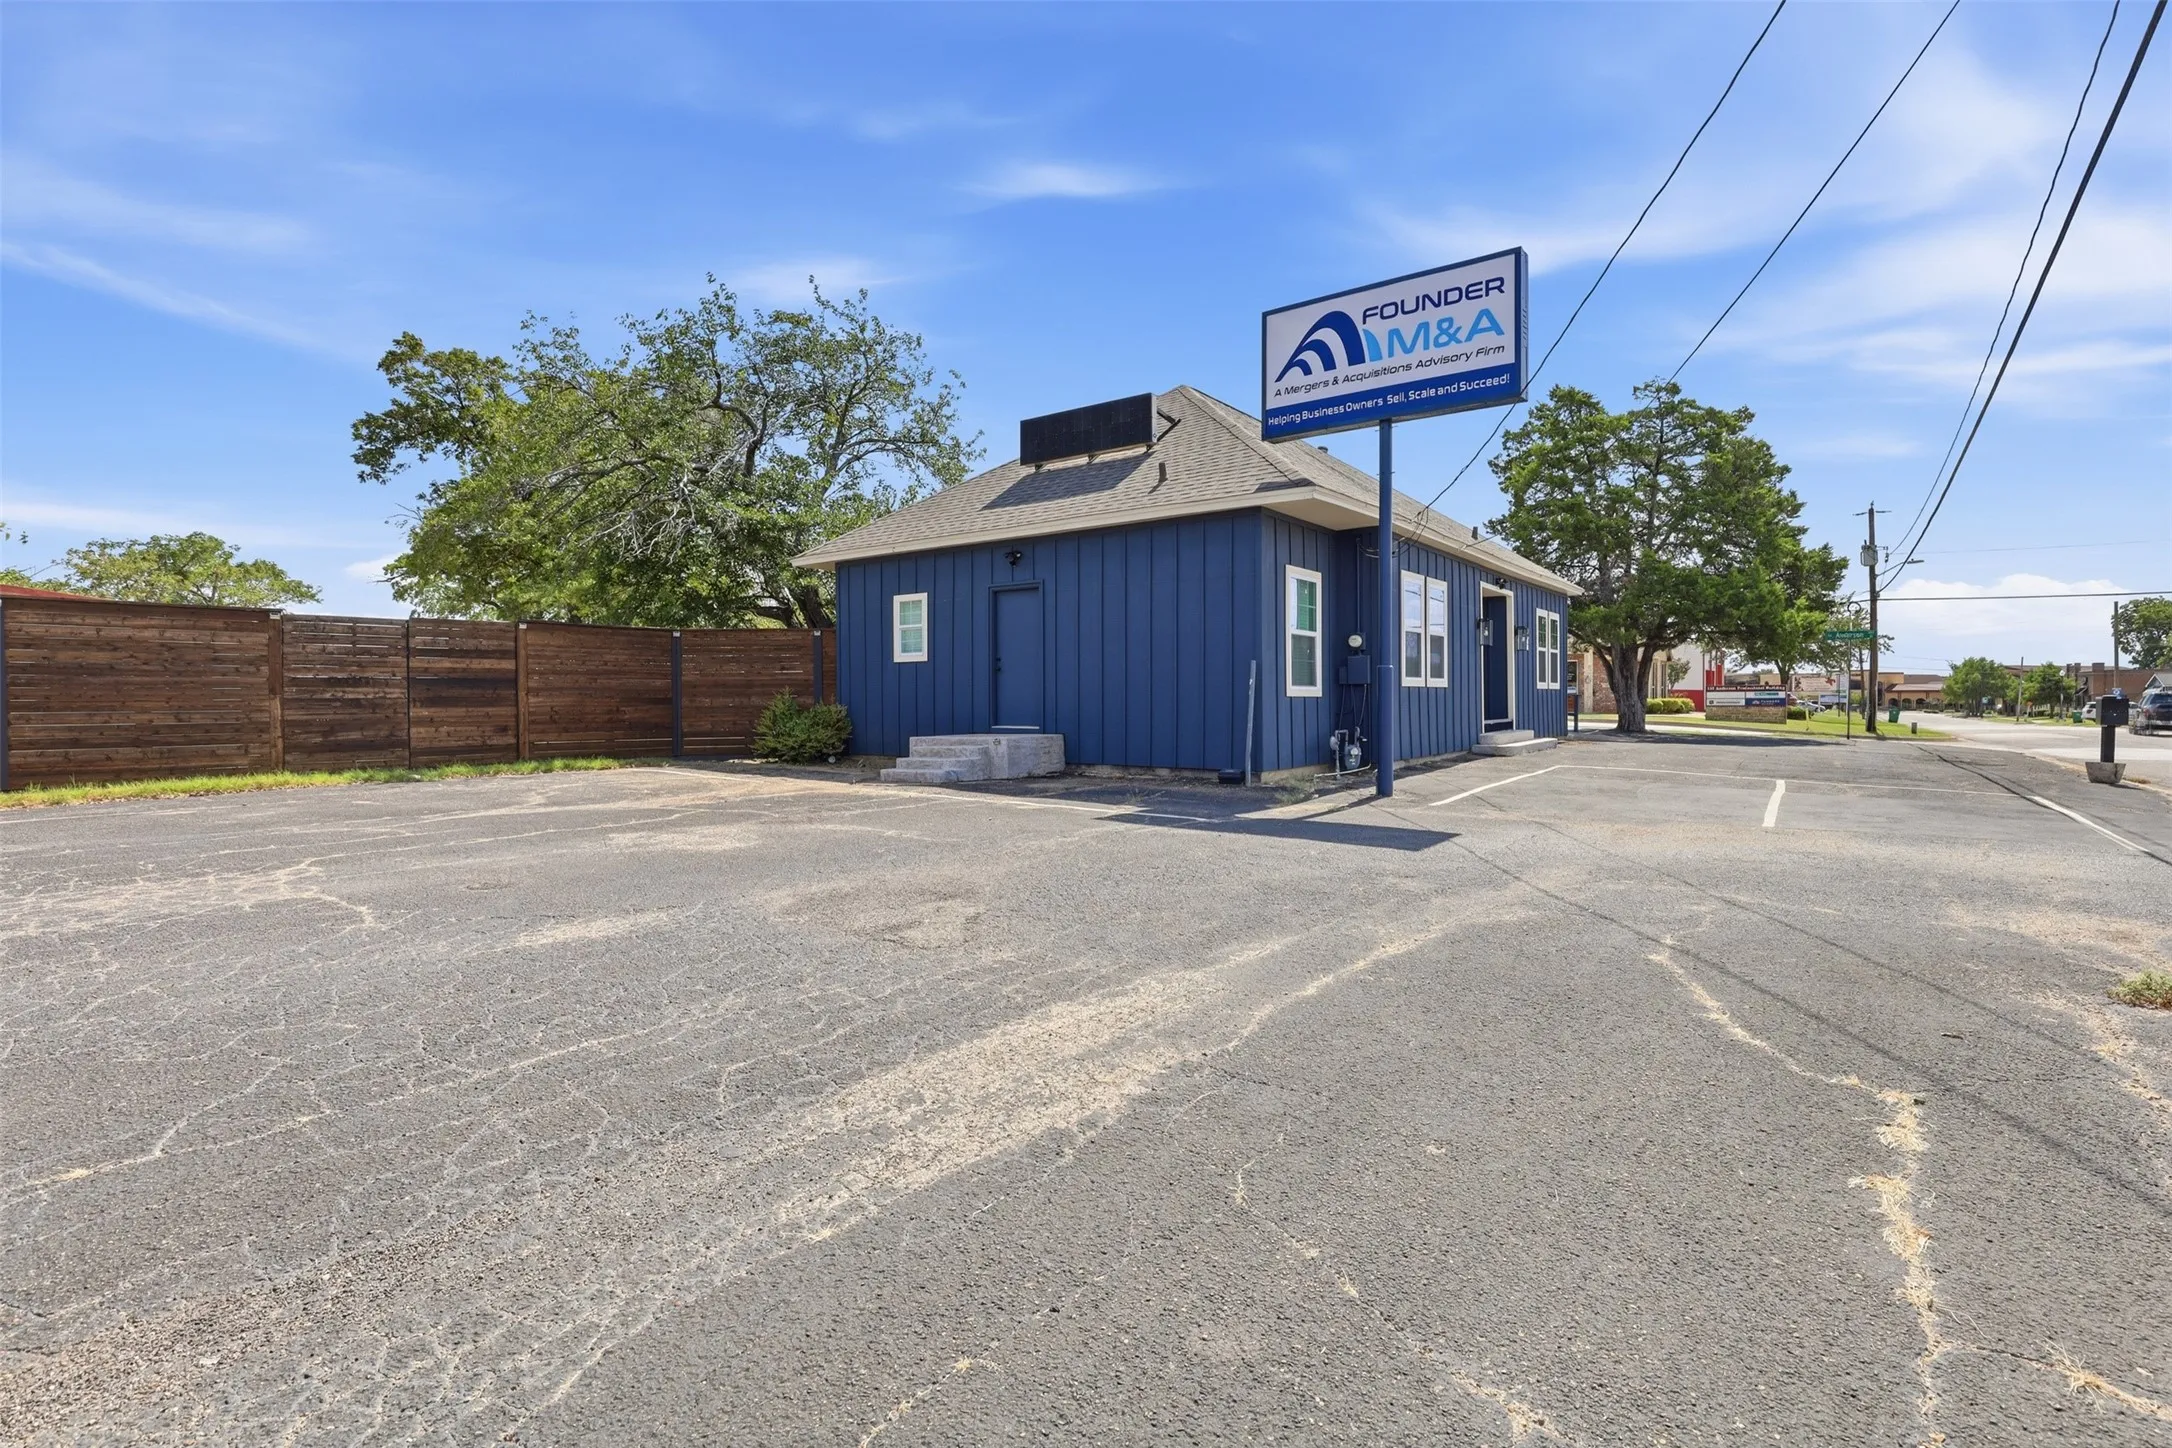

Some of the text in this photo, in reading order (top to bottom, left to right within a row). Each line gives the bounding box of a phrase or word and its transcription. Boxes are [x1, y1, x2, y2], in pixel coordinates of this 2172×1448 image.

[1362, 276, 1505, 325] FOUNDER
[1388, 308, 1505, 359] M&A
[1274, 344, 1505, 397] A Mergers & Acquisitions Advisory Firm
[1268, 373, 1510, 426] Helping Business Owners Sell, Scale and Succeed!
